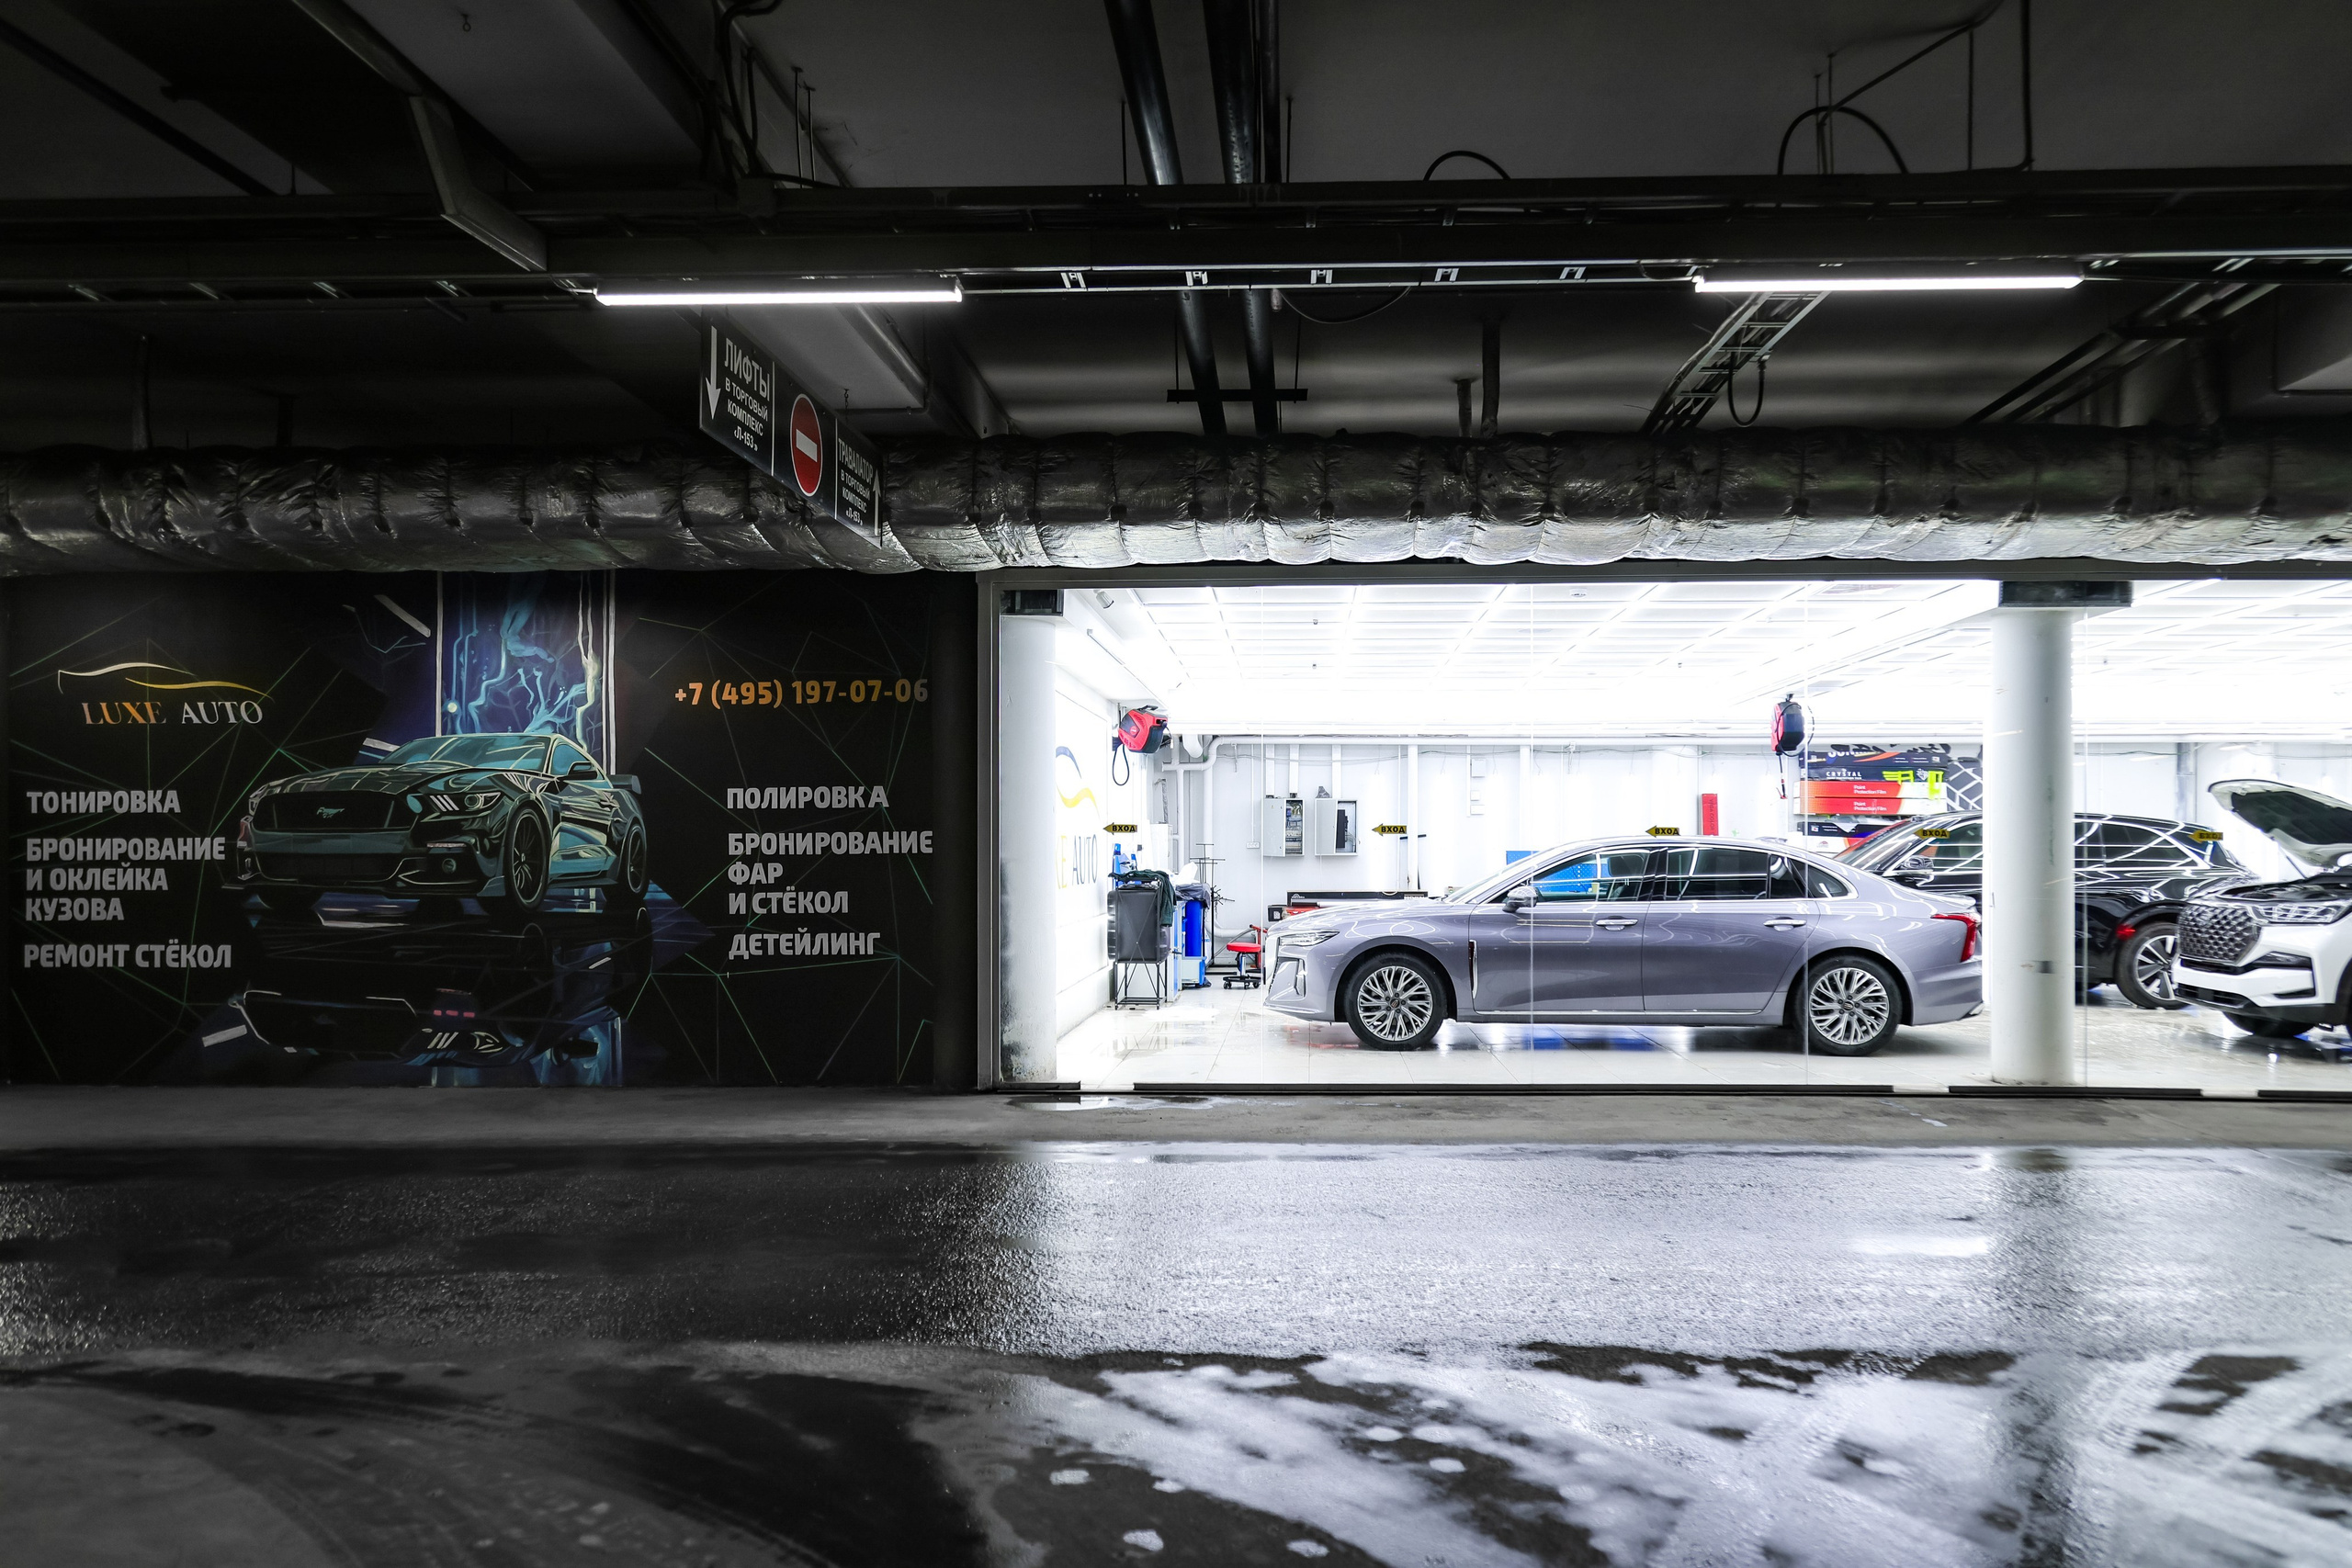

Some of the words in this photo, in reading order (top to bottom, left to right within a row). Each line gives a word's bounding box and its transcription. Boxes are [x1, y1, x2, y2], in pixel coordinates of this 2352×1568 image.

[724, 337, 770, 401] ЛИФТЫ
[725, 377, 730, 392] В
[731, 381, 768, 422] ТОРГОВЫЙ
[727, 399, 763, 436] КОМПЛЕКС
[838, 437, 874, 485] ТРАВАЛАТОР
[841, 468, 845, 481] В
[674, 682, 703, 705] +7
[711, 679, 783, 710] (495)
[792, 678, 928, 705] 197-07-06
[82, 701, 167, 725] LUXE
[181, 700, 264, 725] AUTO
[27, 790, 181, 814] ТОНИРОВКА
[727, 785, 889, 809] ПОЛИРОВКА
[1112, 825, 1136, 833] ВХОД
[1381, 826, 1406, 834] ВХОД
[1655, 828, 1679, 836] ВХОД
[1922, 829, 1947, 838] ВХОД
[26, 837, 226, 862] БРОНИРОВАНИЕ
[728, 830, 933, 856] БРОНИРОВАНИЕ
[1072, 833, 1098, 886] AUTO
[26, 869, 43, 891] И
[50, 862, 168, 891] ОКЛЕЙКА
[727, 862, 784, 886] ФАР
[25, 897, 125, 921] КУЗОВА
[729, 892, 746, 915] И
[752, 886, 849, 914] СТЁКОЛ
[24, 943, 130, 968] РЕМОНТ
[135, 939, 232, 968] СТЁКОЛ
[728, 927, 881, 960] ДЕТЕЙЛИНГ
